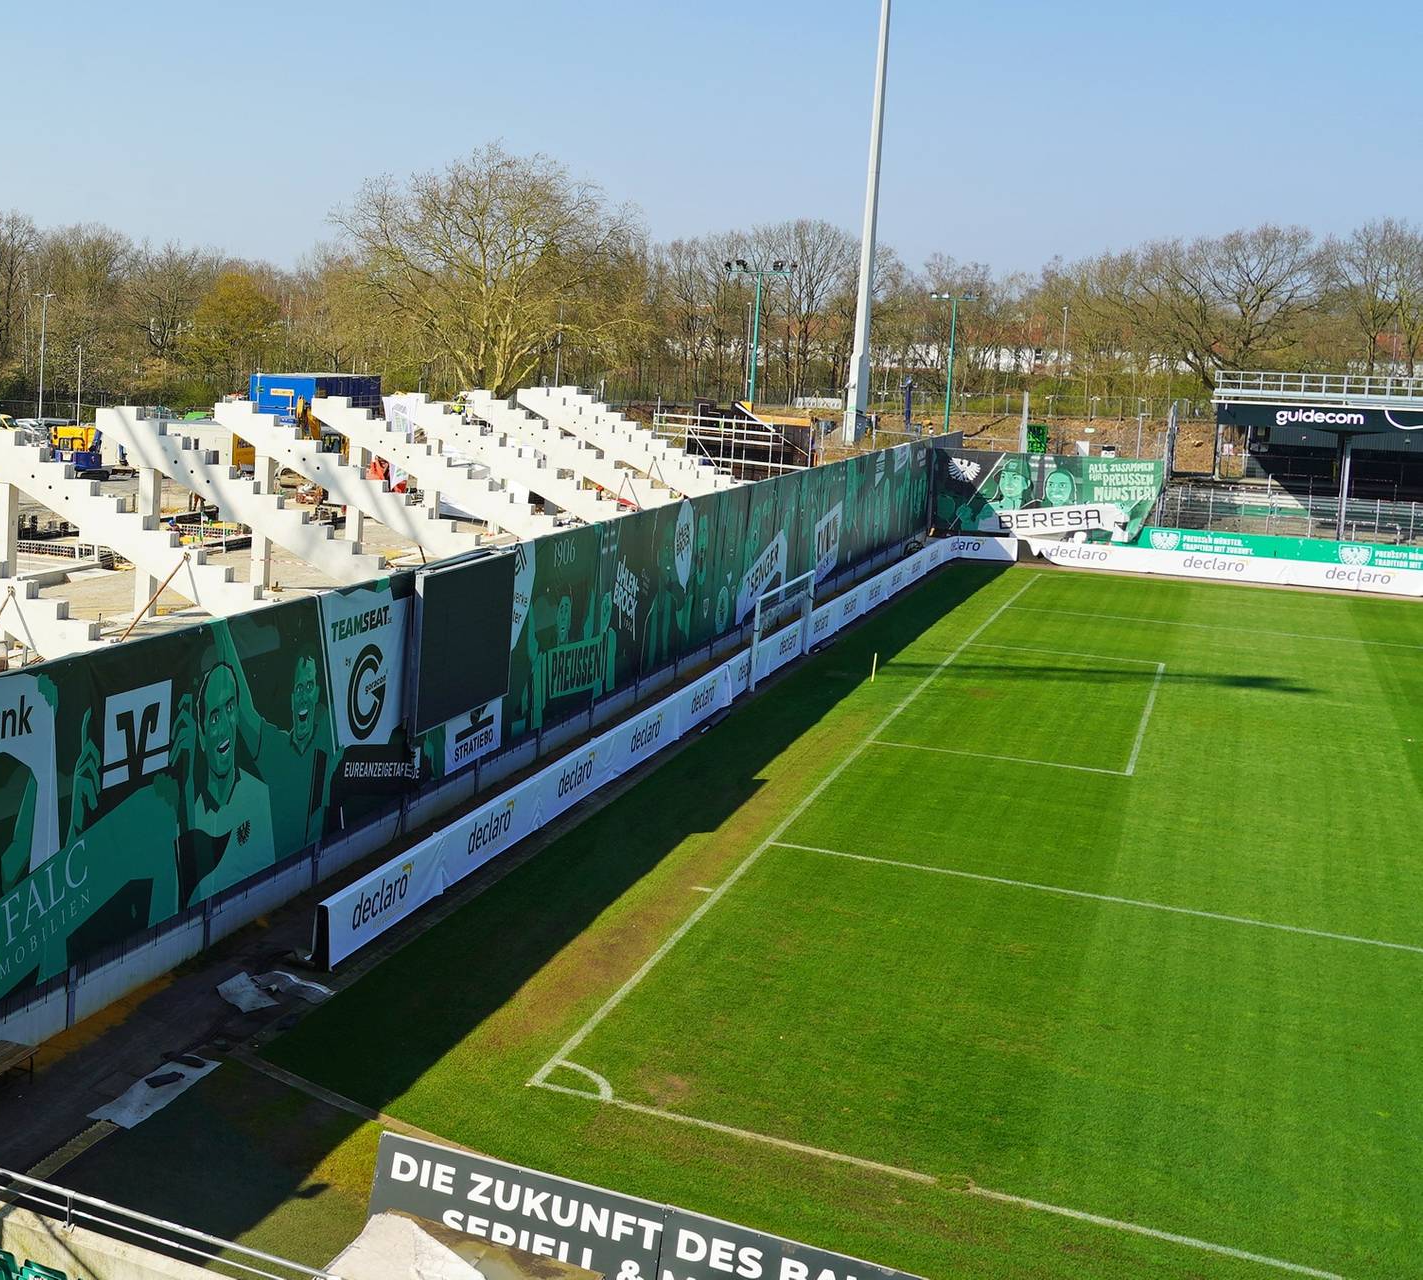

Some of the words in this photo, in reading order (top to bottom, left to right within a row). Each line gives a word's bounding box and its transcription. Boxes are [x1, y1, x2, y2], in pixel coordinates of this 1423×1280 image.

[1276, 409, 1364, 426] guidecom
[1089, 463, 1109, 473] ALLE
[1110, 463, 1155, 472] ZUSAMMEN
[1102, 474, 1154, 486] PREUSSEN
[1094, 485, 1157, 501] MÜNSTER!
[999, 509, 1101, 530] BERESA
[554, 536, 577, 568] 1906
[1051, 545, 1108, 562] declaro
[1183, 556, 1246, 573] declaro
[1325, 567, 1391, 585] declaro
[690, 685, 715, 715] declaro
[630, 719, 661, 753] declaro
[557, 759, 594, 798] declaro
[467, 809, 512, 856] declaro
[0, 839, 89, 946] FALC
[352, 873, 409, 931] declaro
[390, 1151, 456, 1195] DIE
[466, 1173, 663, 1250] ZUKUNFT
[676, 1228, 764, 1279] DES
